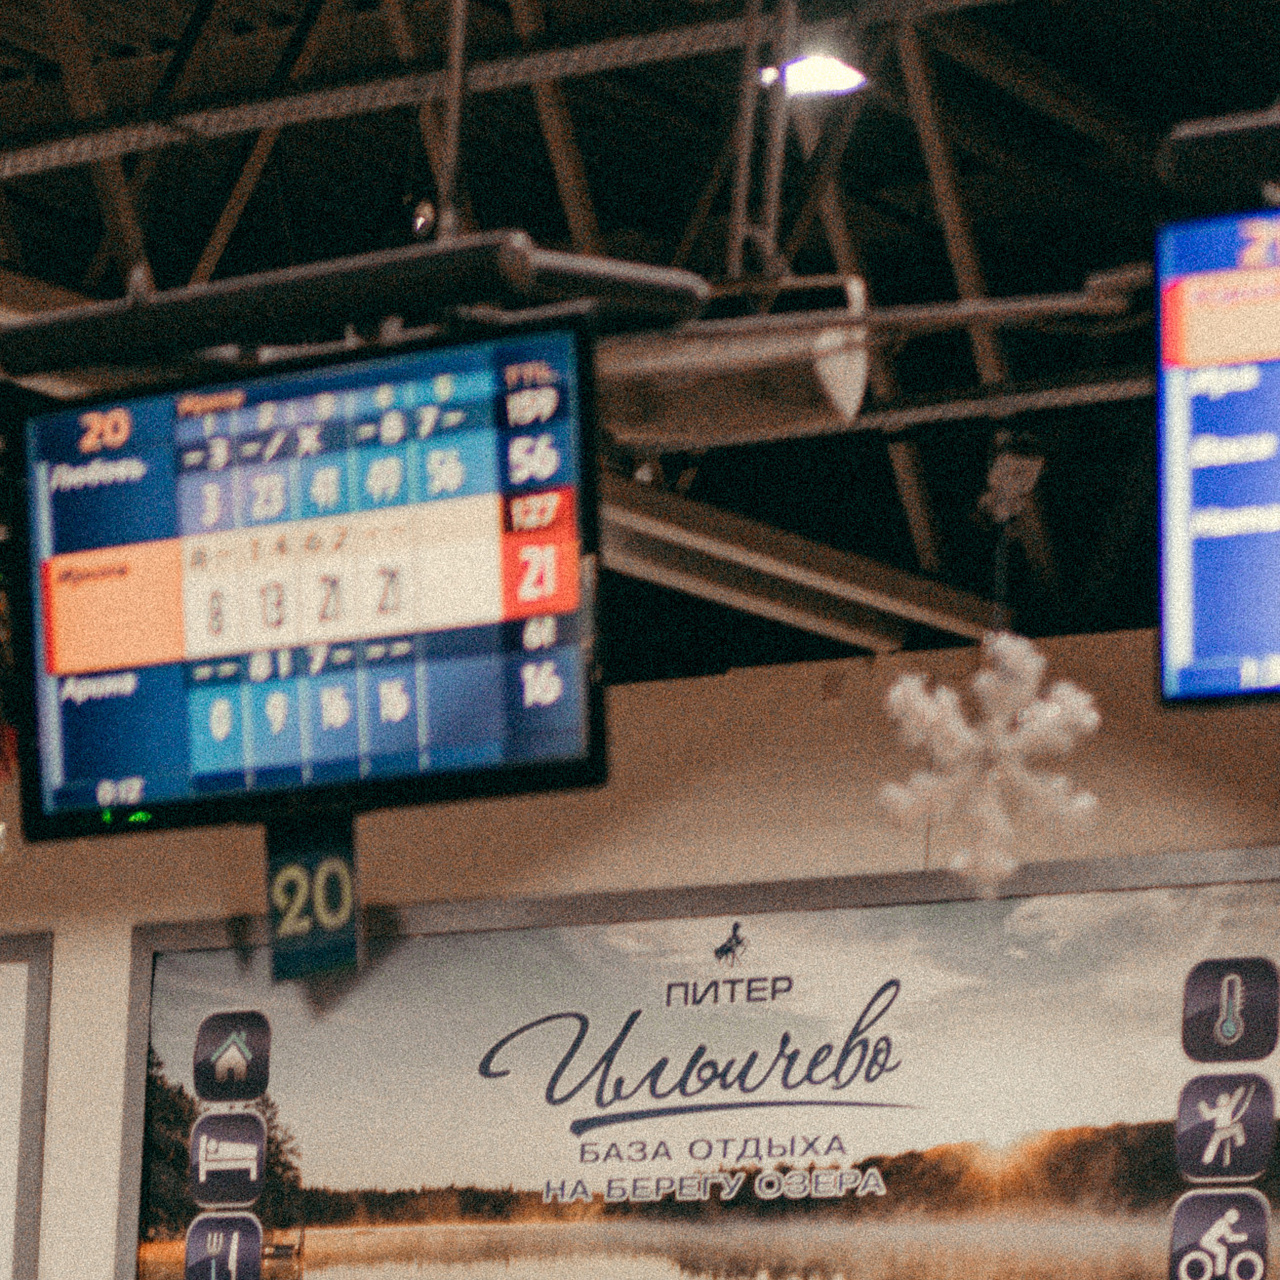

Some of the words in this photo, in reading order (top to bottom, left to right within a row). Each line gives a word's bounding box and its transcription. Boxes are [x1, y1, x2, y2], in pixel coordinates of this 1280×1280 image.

[78, 407, 132, 454] 20
[507, 433, 560, 484] 56
[517, 544, 558, 603] 21
[520, 660, 563, 708] 16
[273, 858, 352, 937] 20
[666, 975, 794, 1008] ПИТЕР
[477, 977, 904, 1109] Ильичево
[578, 1139, 674, 1166] БАЗА
[687, 1133, 848, 1165] ОТДЫХА
[542, 1177, 596, 1204] НА
[605, 1170, 748, 1202] БЕРЕГУ
[754, 1165, 888, 1200] ОЗЕРА
